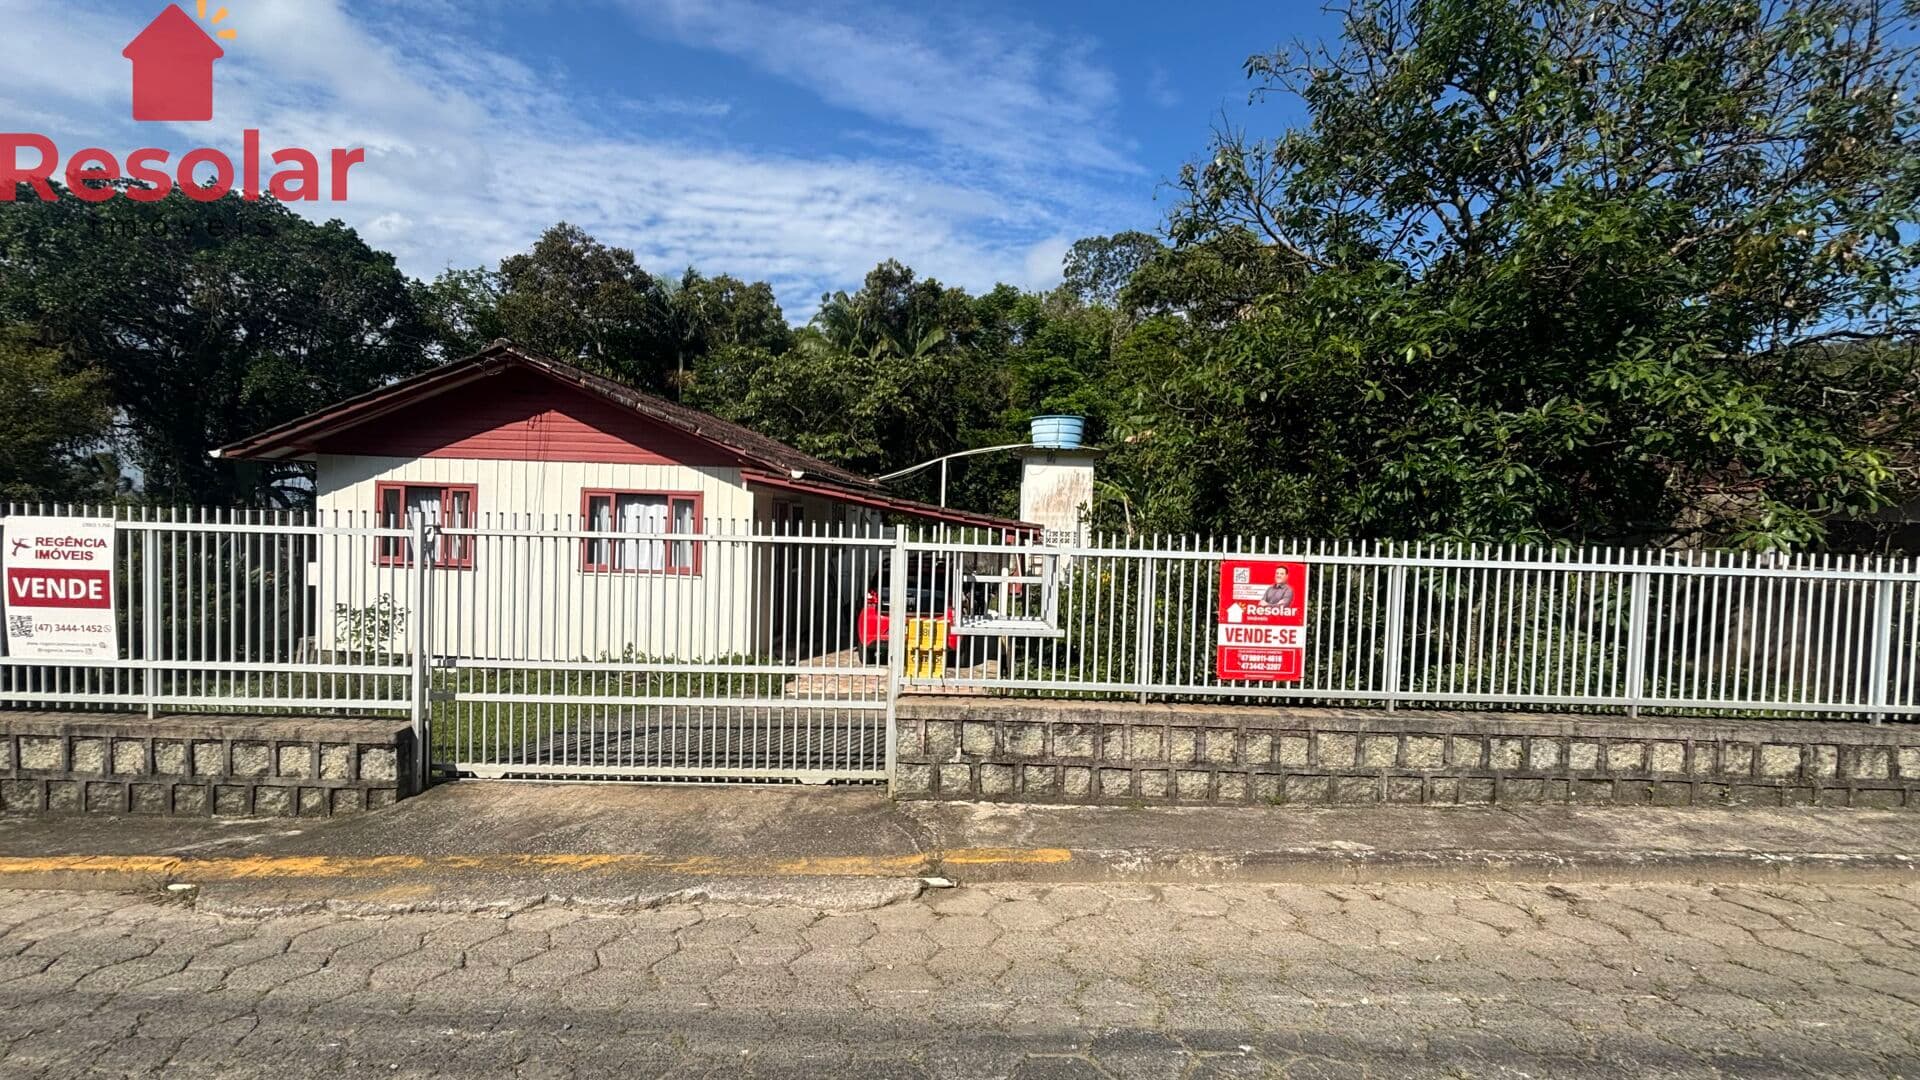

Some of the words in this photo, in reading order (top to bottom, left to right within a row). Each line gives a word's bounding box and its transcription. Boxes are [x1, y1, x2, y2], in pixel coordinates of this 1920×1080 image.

[35, 536, 107, 548] REGÊNCIA
[35, 548, 94, 560] IMÓVEIS
[12, 577, 103, 600] VENDE
[1246, 604, 1297, 616] Resolar
[35, 623, 52, 633] (47)
[55, 623, 103, 633] 3444-1452
[1225, 627, 1297, 644] VENDE-SE
